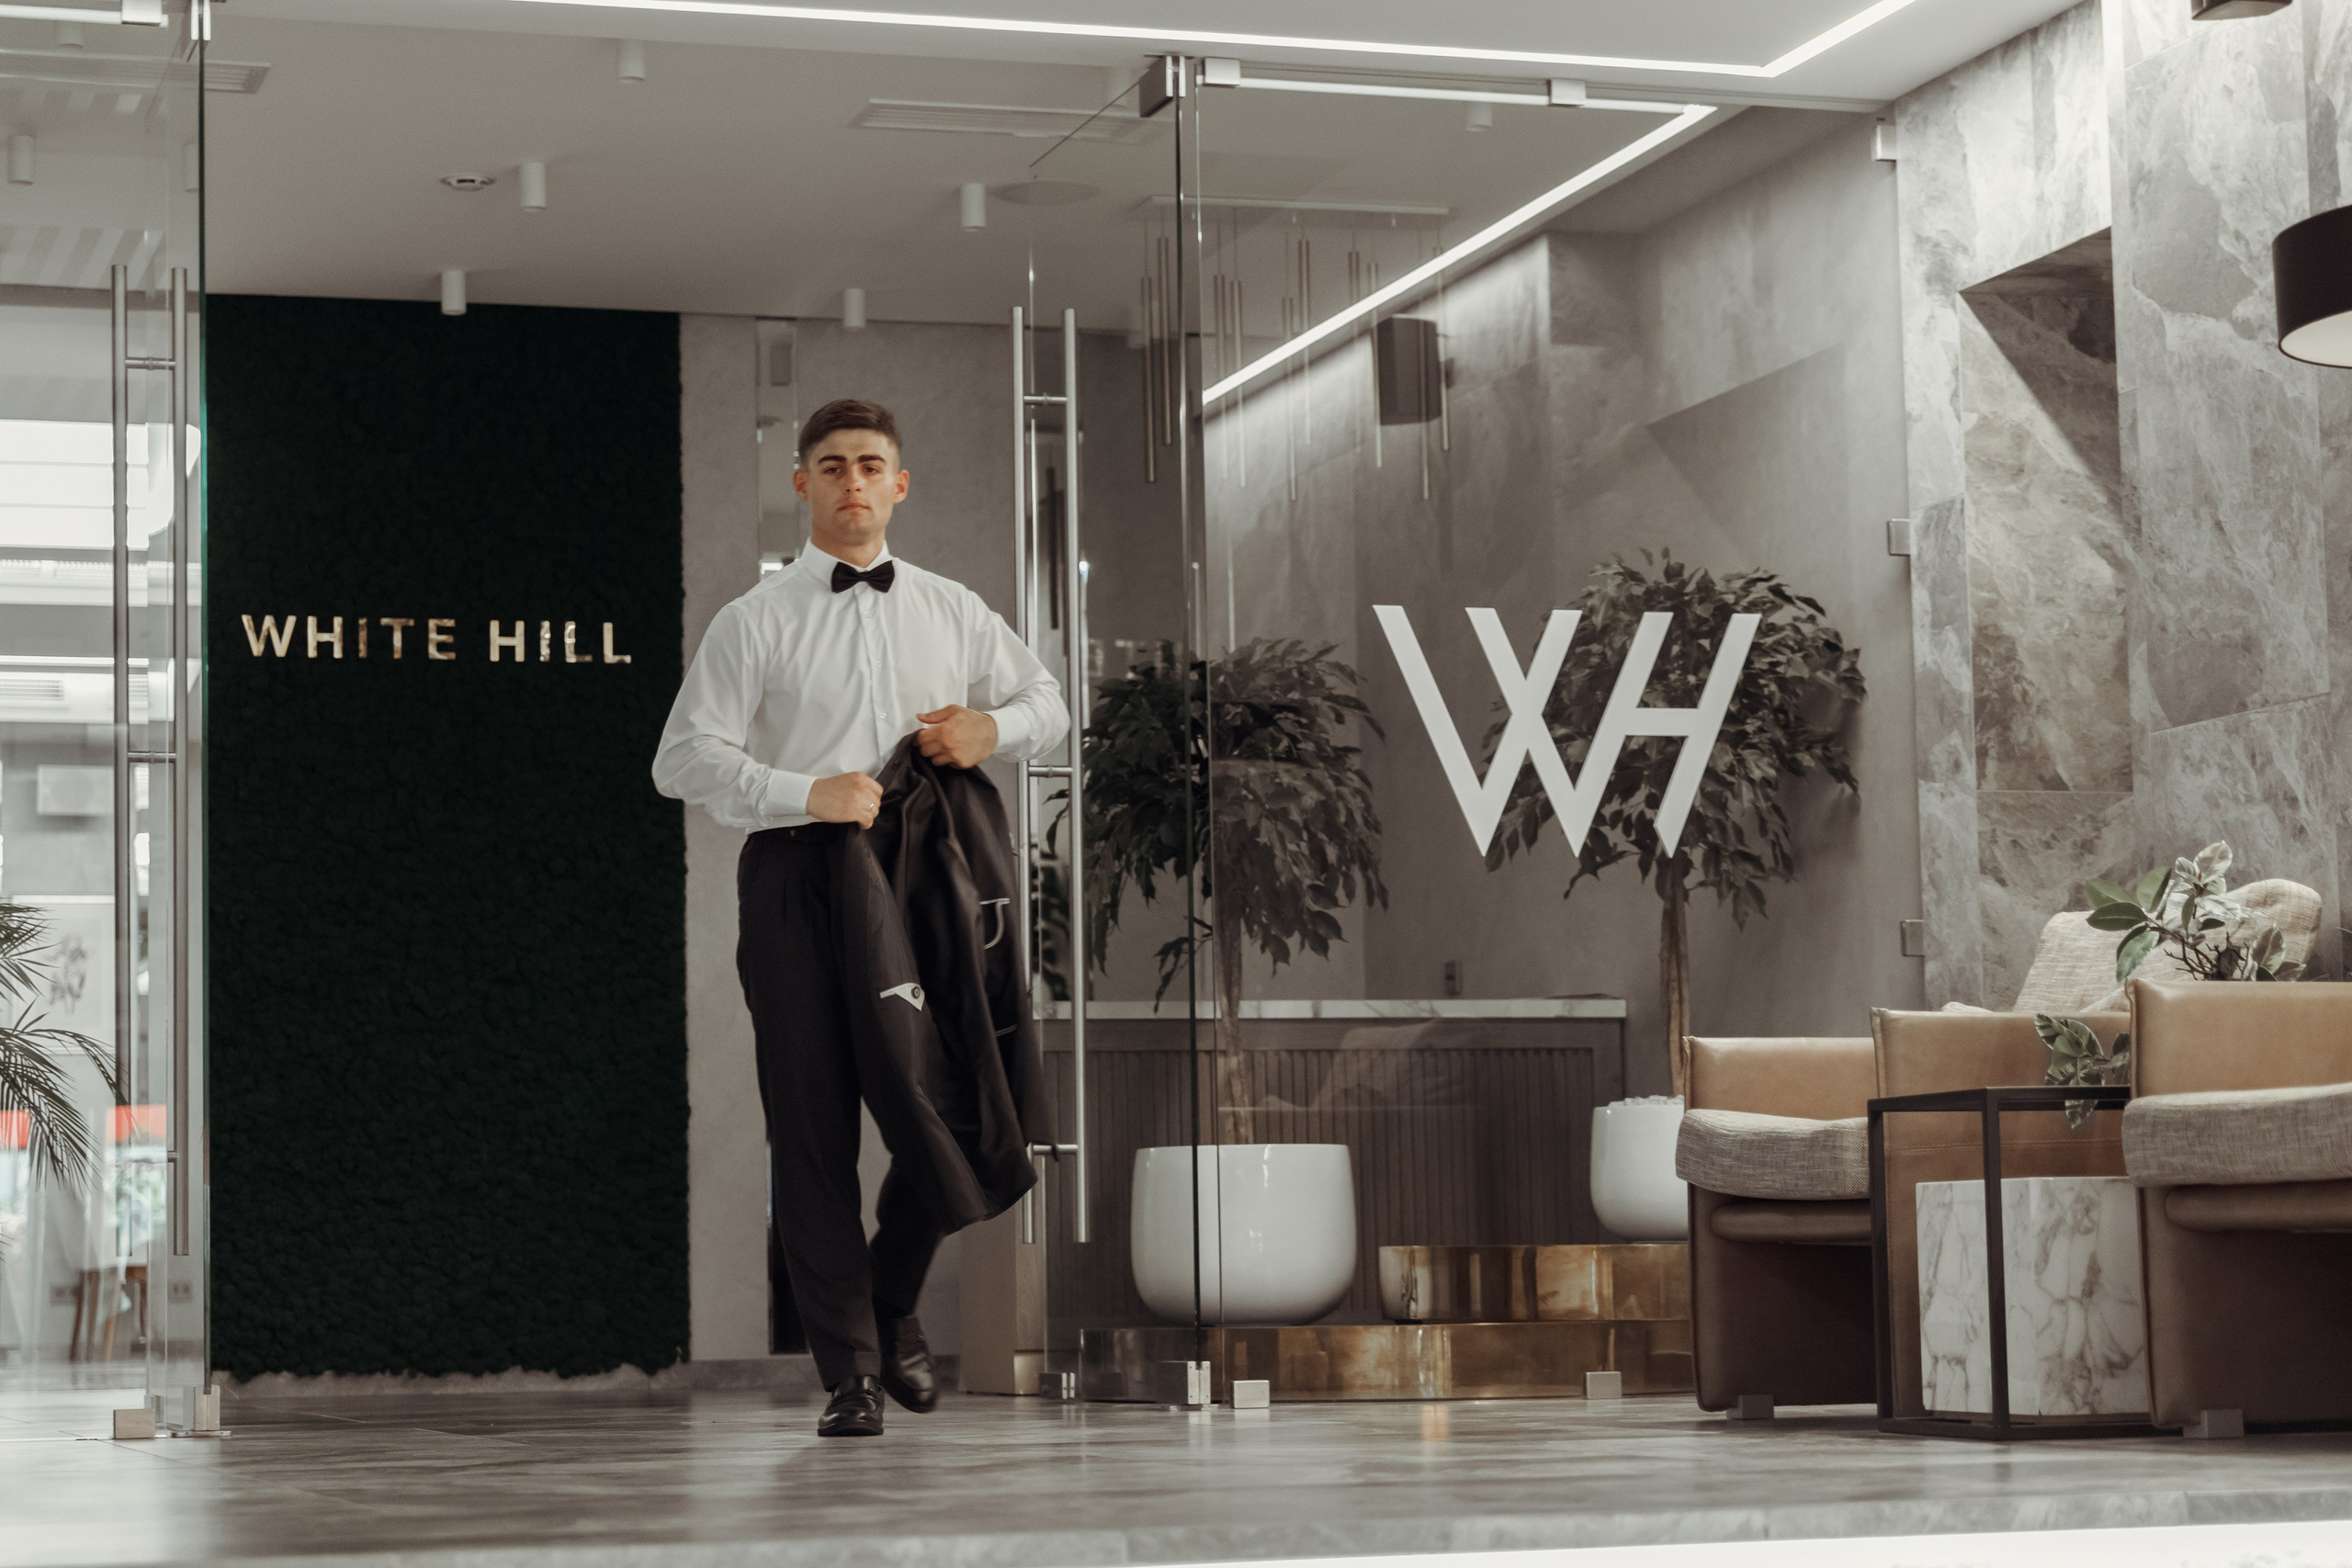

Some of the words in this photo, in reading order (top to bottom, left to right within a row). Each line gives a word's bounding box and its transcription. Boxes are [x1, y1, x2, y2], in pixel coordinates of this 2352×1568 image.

[241, 614, 457, 660] WHITE
[490, 620, 632, 664] HILL
[1372, 604, 1762, 859] WH
